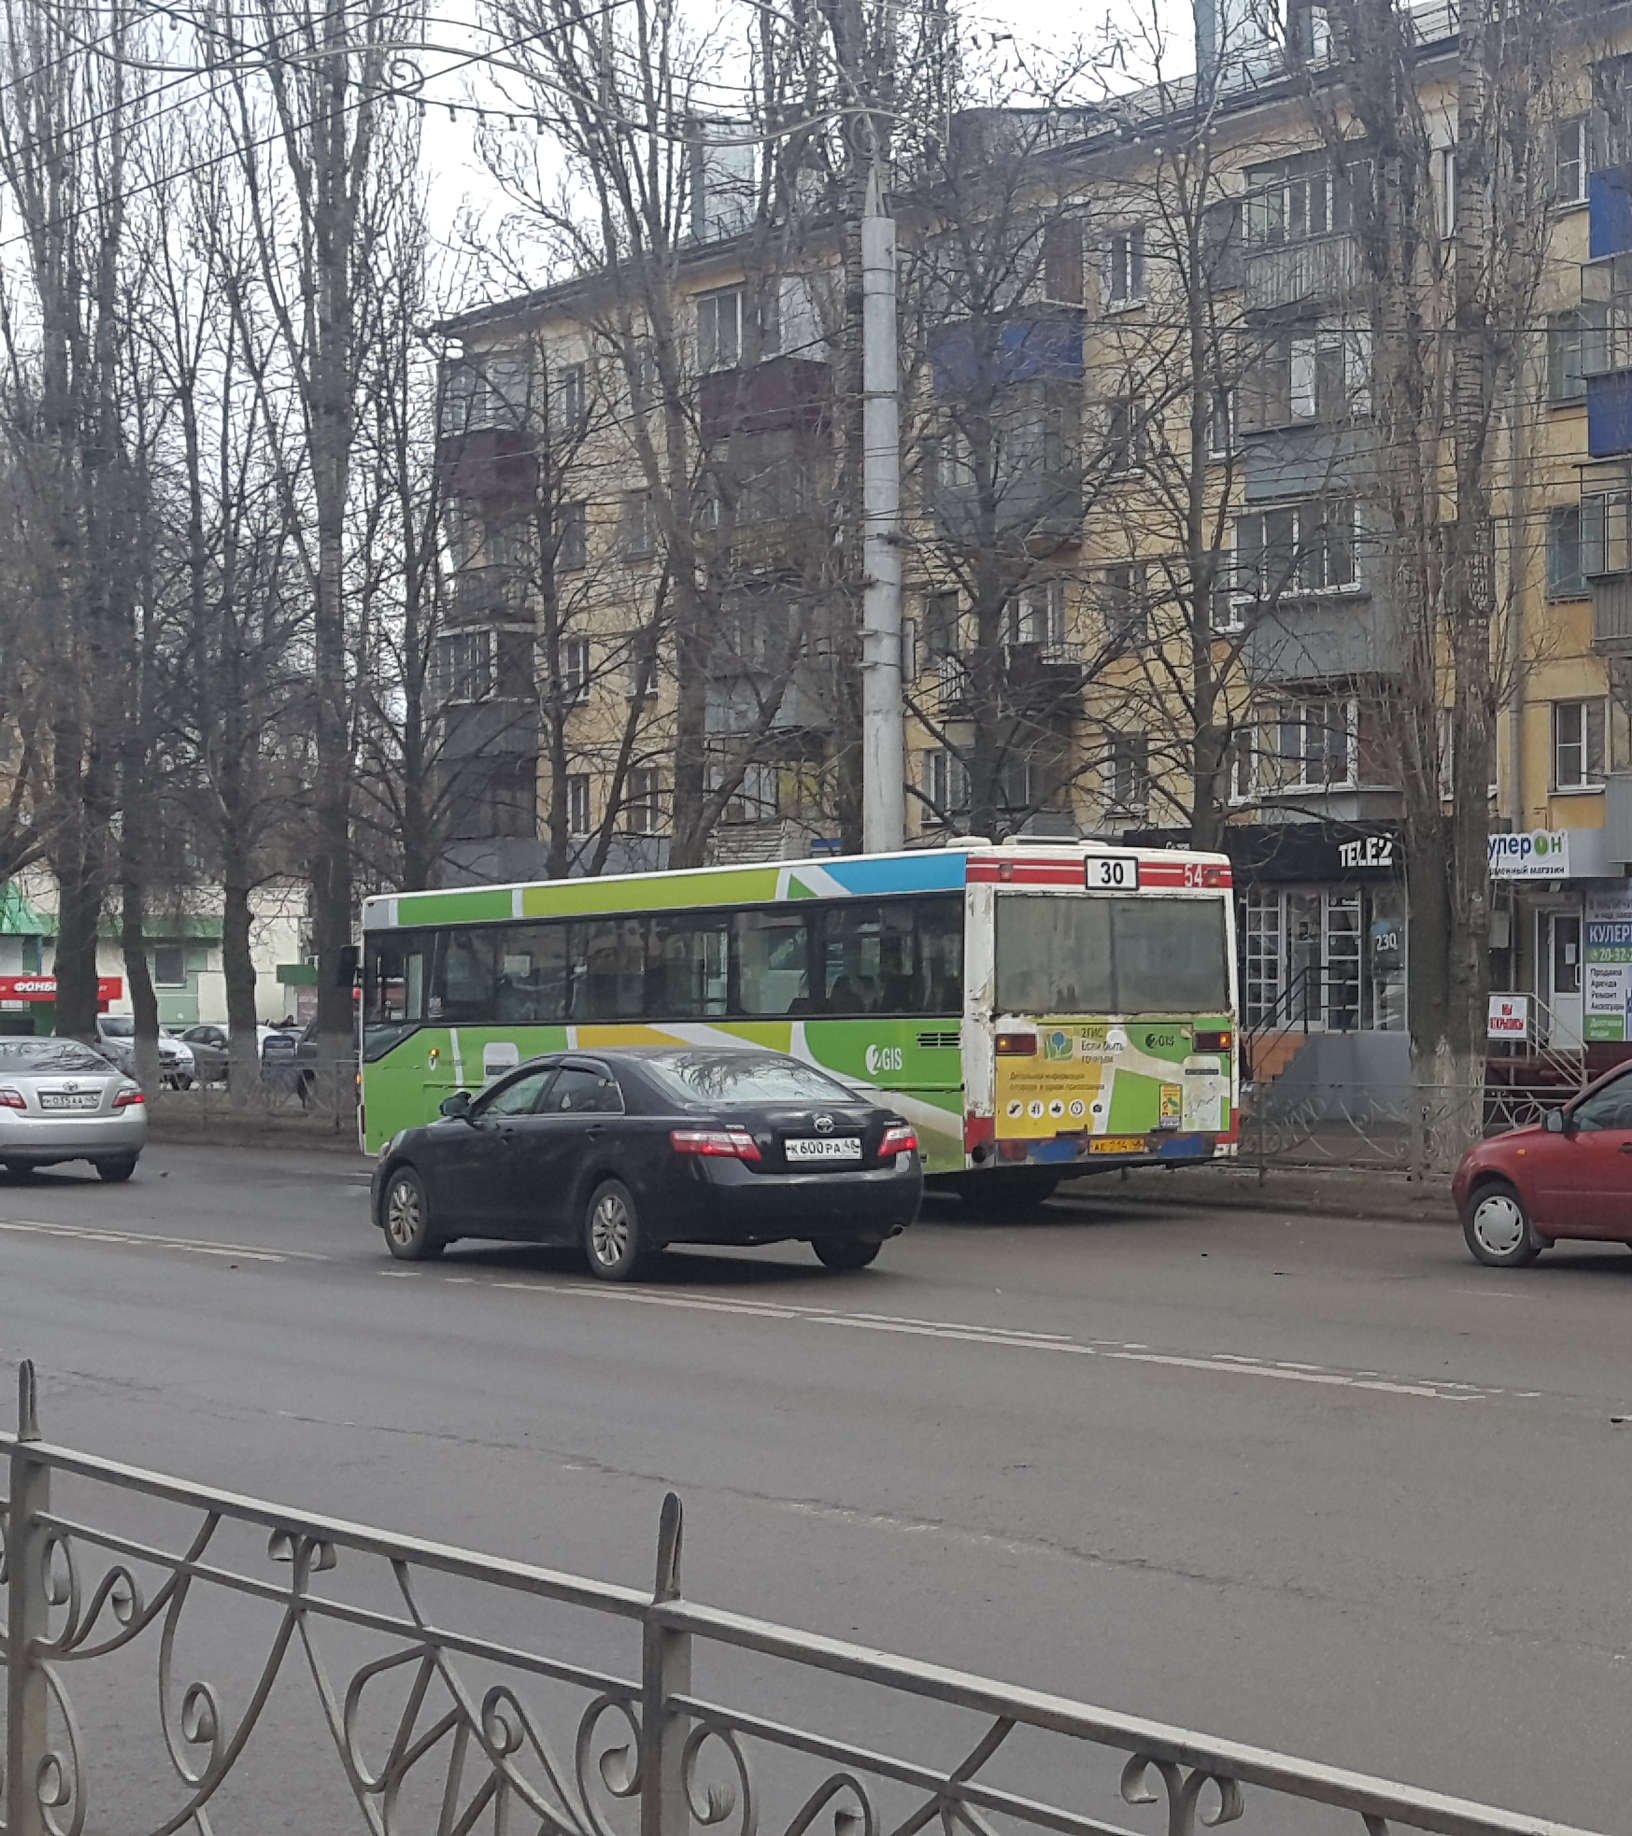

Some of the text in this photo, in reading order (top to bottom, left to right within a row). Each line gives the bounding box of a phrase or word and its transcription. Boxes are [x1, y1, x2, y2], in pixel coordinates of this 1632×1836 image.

[1338, 832, 1393, 867] TELE2
[1101, 862, 1124, 885] 30
[1184, 864, 1203, 887] 54
[790, 1141, 841, 1154] К600РА
